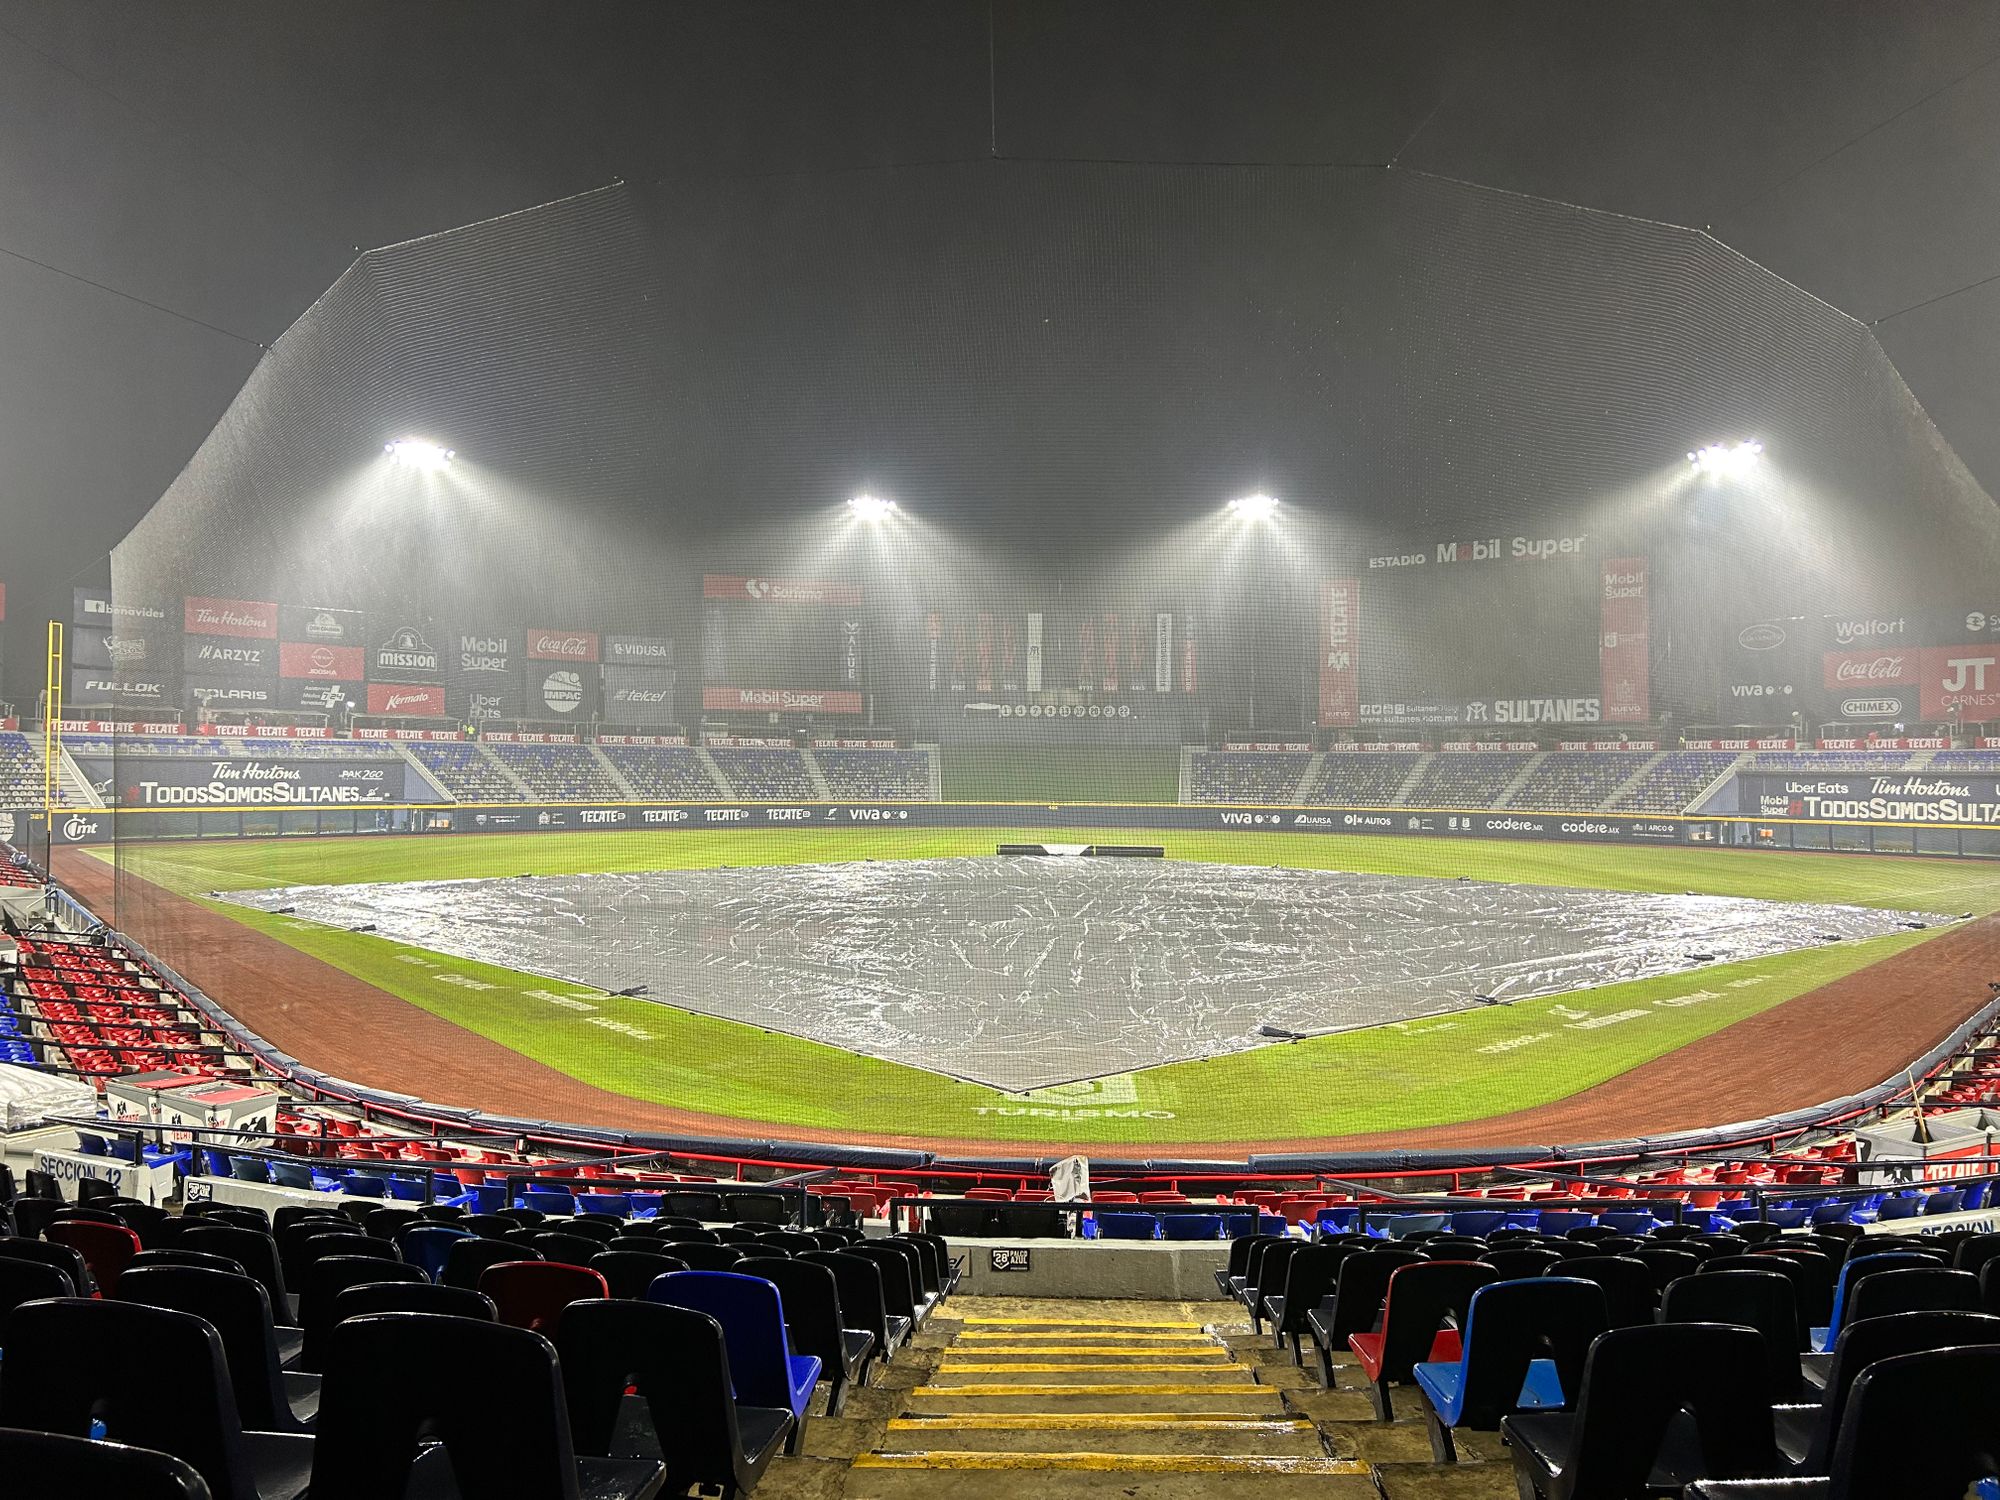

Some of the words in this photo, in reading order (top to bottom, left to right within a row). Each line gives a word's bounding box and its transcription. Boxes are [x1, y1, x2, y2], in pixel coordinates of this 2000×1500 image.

[1369, 553, 1426, 568] ESTADIO
[1436, 539, 1501, 563] Mobil
[1511, 536, 1585, 559] Super
[1605, 572, 1644, 585] Mobil
[1605, 585, 1643, 597] Super
[105, 604, 165, 618] benavides
[1330, 587, 1348, 647] TECATE
[197, 609, 220, 624] Tim
[220, 610, 268, 628] Hortons
[1836, 617, 1905, 637] Walfort
[461, 636, 508, 653] Mobil
[537, 635, 588, 656] Coca-Cola
[624, 644, 667, 656] VIDUSA
[461, 653, 508, 670] Super
[1837, 656, 1906, 681] Coca-Cola
[1942, 657, 1995, 691] JT
[193, 688, 267, 700] POLARIS
[470, 693, 502, 706] Uber
[544, 691, 582, 700] IMPAC
[628, 690, 667, 702] telcel
[740, 690, 780, 704] Mobil
[782, 692, 824, 706] Super
[385, 692, 429, 710] Kermato
[1845, 701, 1895, 711] CHIMEX
[1941, 694, 1996, 707] CARNES
[1494, 699, 1600, 722] SULTANES
[51, 721, 90, 731] TECATE
[97, 721, 135, 733] TECATE
[143, 722, 179, 734] TECATE
[214, 725, 249, 736] TECATE
[256, 725, 288, 736] TECATE
[294, 727, 325, 737] TECATE
[359, 729, 388, 738] TECATE
[395, 730, 423, 739] TECATE
[431, 731, 458, 740] TECATE
[486, 732, 512, 742] TECATE
[517, 733, 544, 742] TECATE
[549, 734, 575, 743] TECATE
[600, 735, 626, 743] TECATE
[630, 736, 656, 744] TECATE
[659, 736, 685, 745] TECATE
[709, 738, 734, 746] TECATE
[737, 738, 763, 746] TECATE
[766, 739, 791, 747] TECATE
[815, 740, 839, 748] TECATE
[842, 740, 867, 748] TECATE
[871, 740, 896, 748] TECATE
[1226, 743, 1251, 751] TECATE
[1255, 743, 1280, 751] TECATE
[1284, 743, 1309, 751] TECATE
[1334, 743, 1359, 751] TECATE
[1363, 743, 1389, 751] TECATE
[1391, 743, 1420, 751] TECATE
[1445, 742, 1471, 751] TECATE
[1475, 742, 1501, 750] TECATE
[1506, 742, 1532, 750] TECATE
[1560, 742, 1587, 750] TECATE
[1592, 742, 1620, 750] TECATE
[1626, 741, 1655, 750] TECATE
[1684, 740, 1713, 750] TECATE
[1720, 740, 1749, 749] TECATE
[1756, 739, 1787, 749] TECATE
[1822, 739, 1855, 749] TECATE
[1907, 738, 1943, 748] TECATE
[211, 761, 241, 779] Tim
[242, 761, 301, 780] Hortons
[1785, 782, 1816, 794] Uber
[1817, 782, 1849, 794] Eats
[1869, 776, 1902, 795] Tim
[1902, 776, 1971, 797] Hortons
[1760, 795, 1788, 805] Mobil
[704, 808, 742, 821] TECATE
[766, 808, 804, 820] TECATE
[1760, 804, 1788, 815] Super
[580, 810, 619, 822] TECATE
[642, 810, 680, 822] TECATE
[1364, 816, 1392, 826] AUTOS
[970, 1106, 1177, 1119] TURISMO
[40, 1156, 96, 1182] SECCION
[105, 1167, 122, 1189] 12
[995, 1253, 1008, 1263] 28
